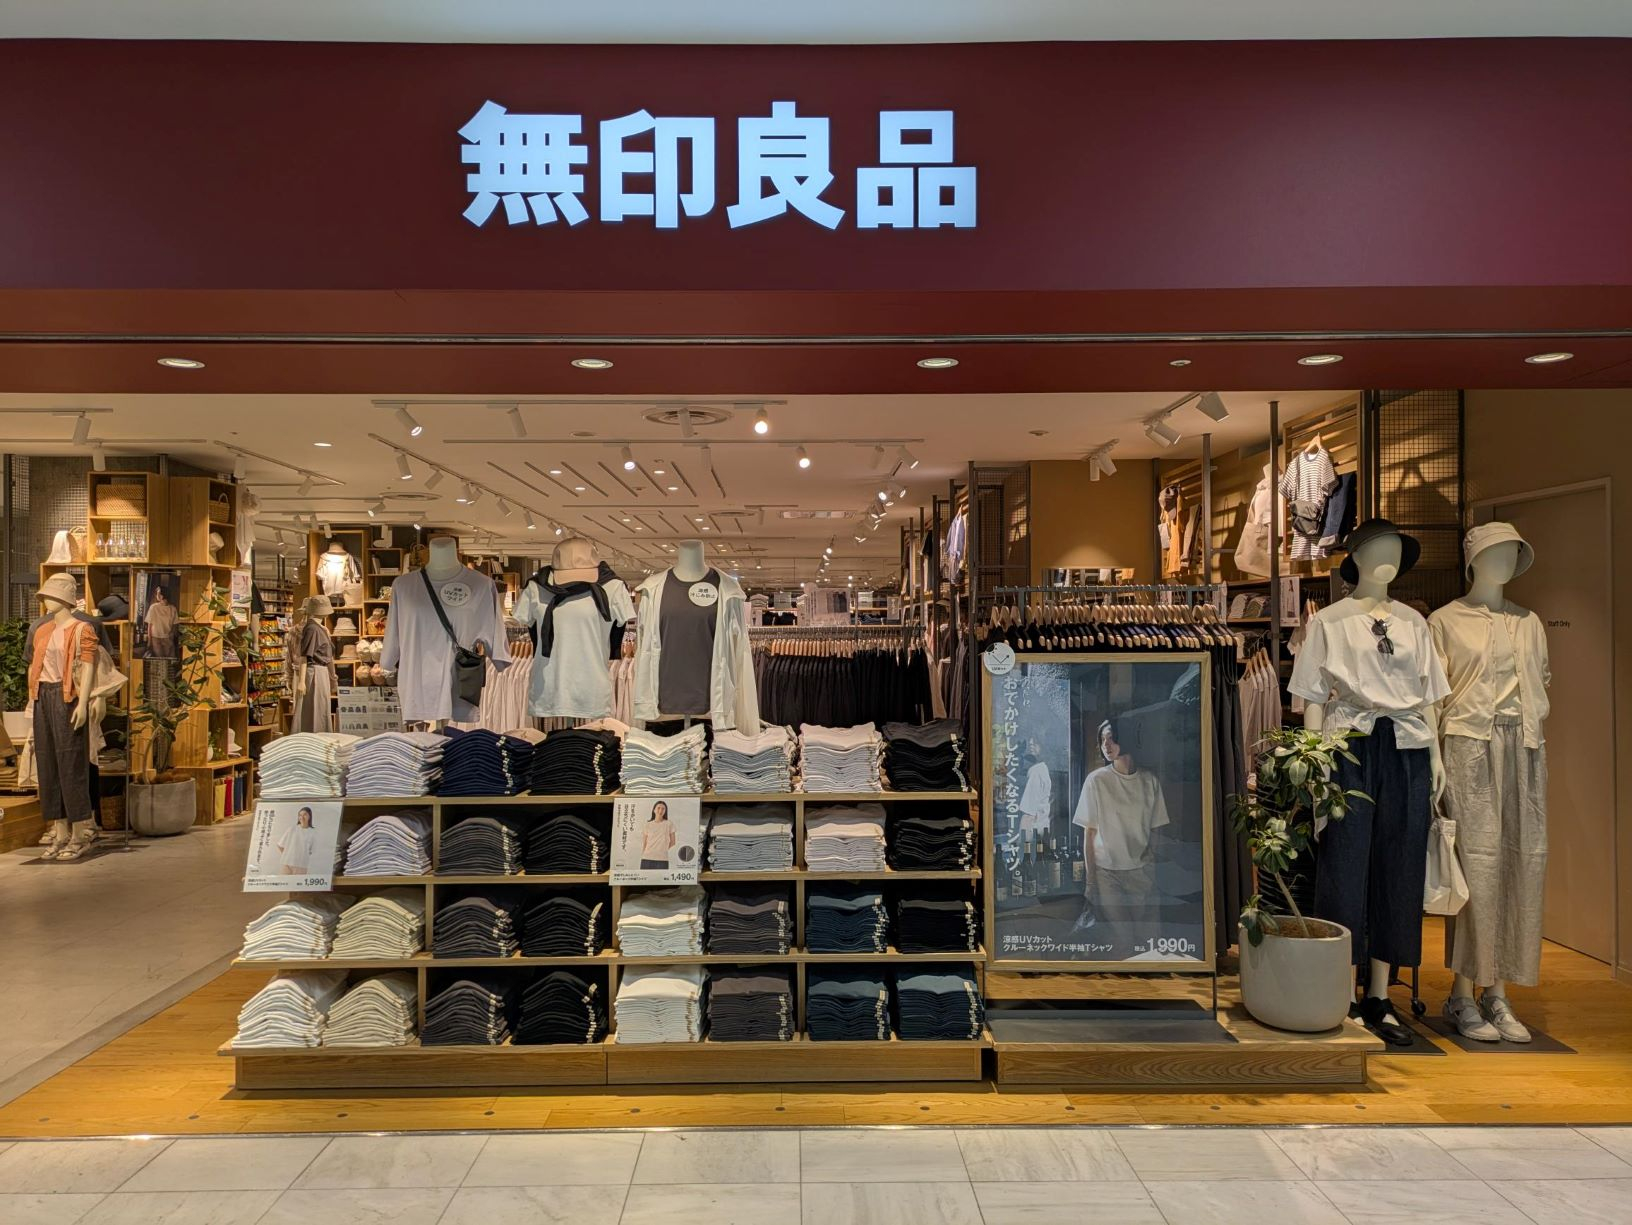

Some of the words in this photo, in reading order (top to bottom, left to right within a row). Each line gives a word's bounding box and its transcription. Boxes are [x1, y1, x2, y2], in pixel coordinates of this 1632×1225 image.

[457, 100, 977, 230] 無印良品
[1560, 620, 1570, 629] Only
[1003, 676, 1021, 876] おでかけしたくなるTシャツ。
[1003, 935, 1053, 943] 涼感UVカット
[1003, 943, 1113, 952] クルーネックワイド半袖Tシャツ
